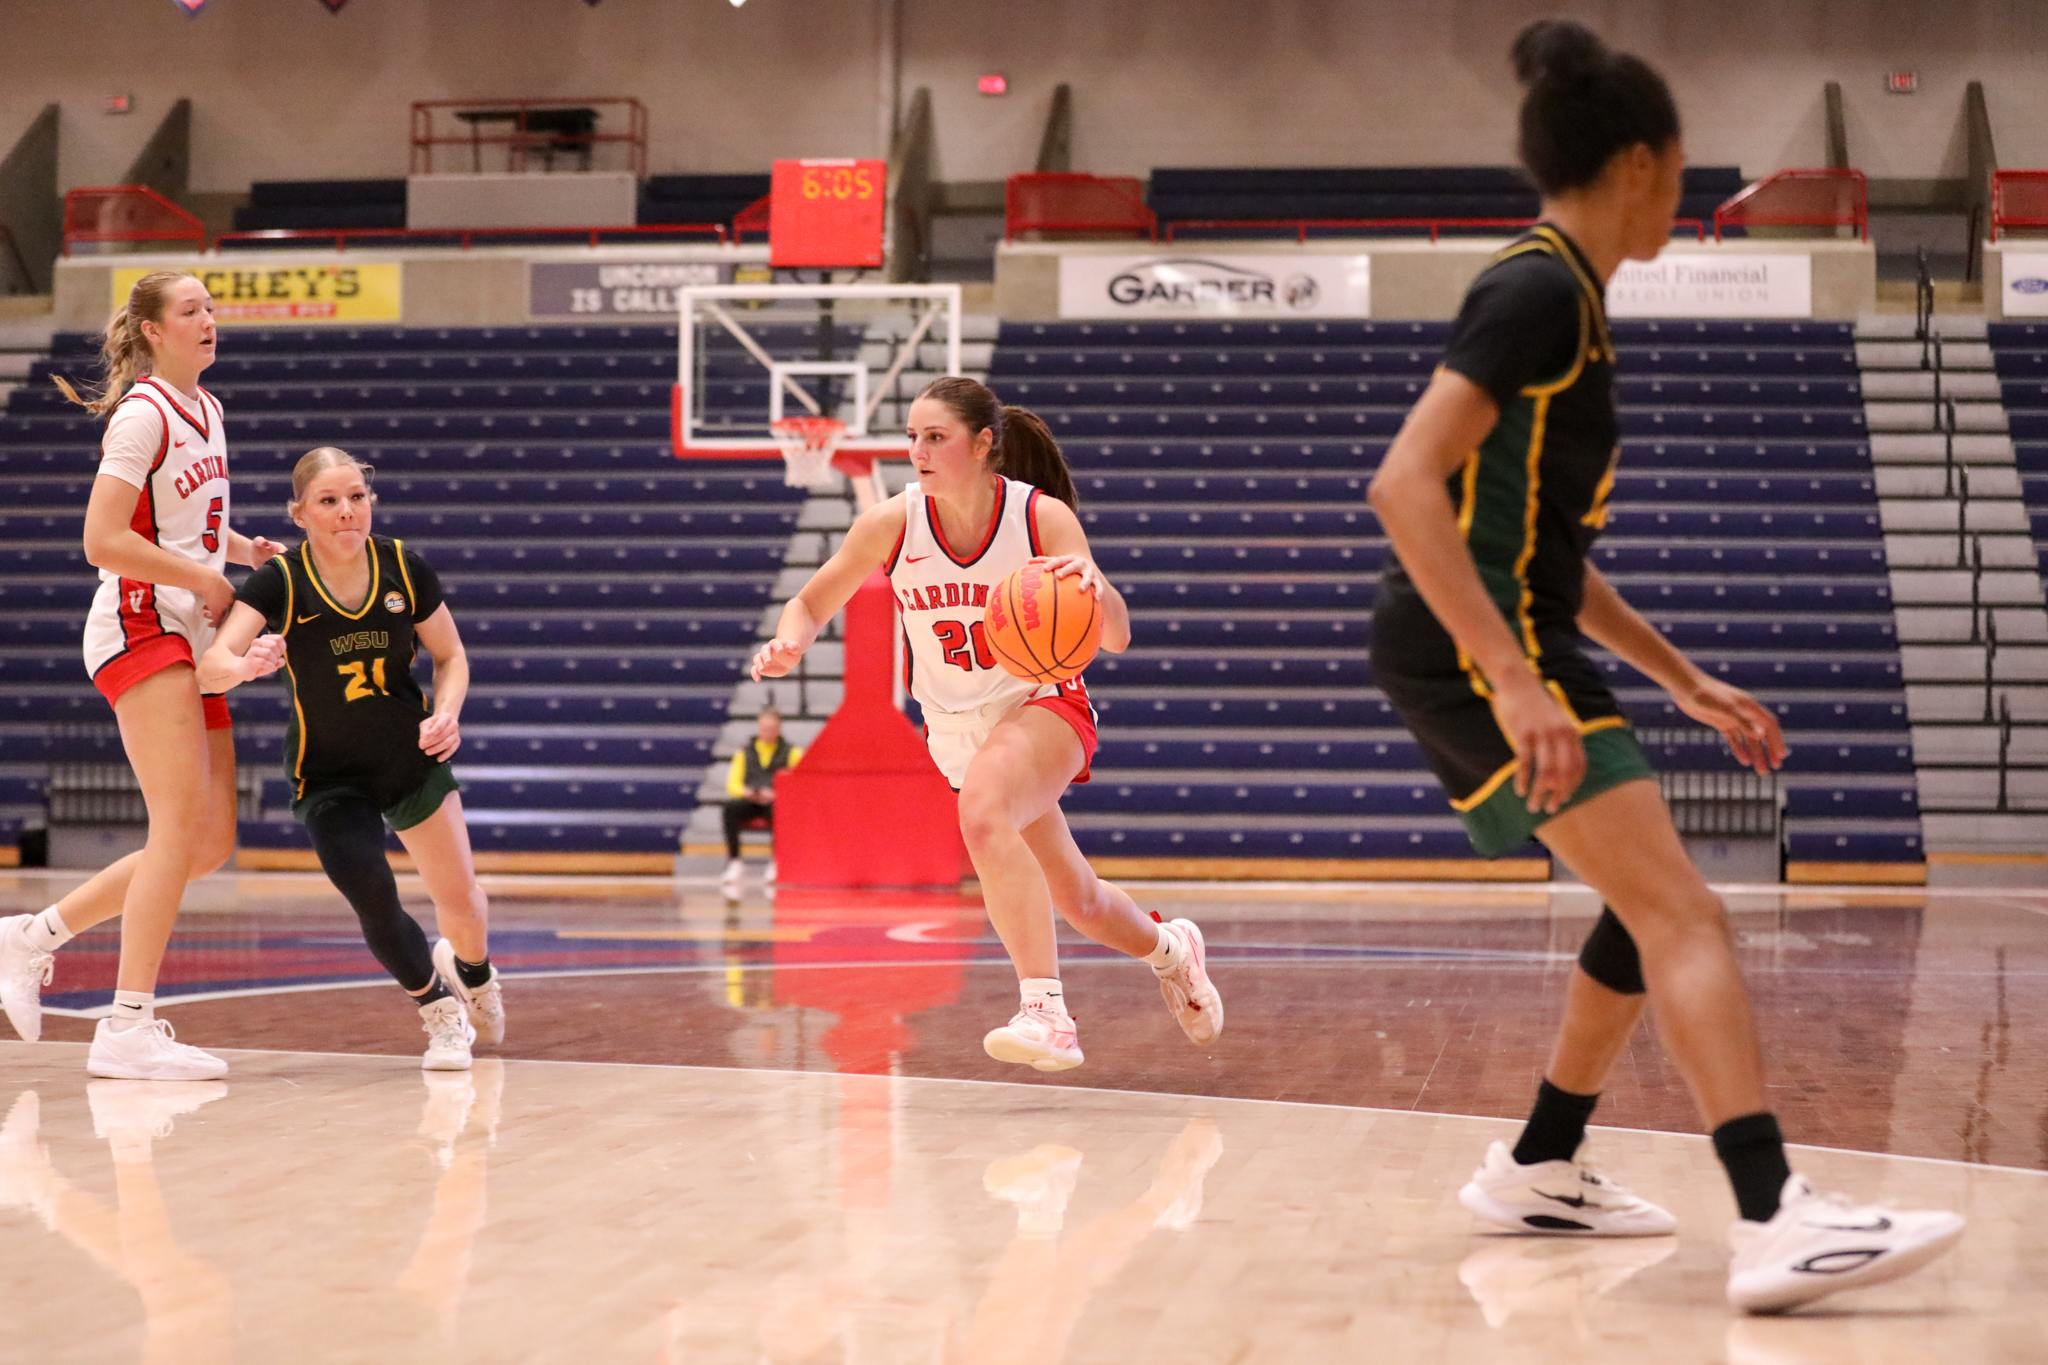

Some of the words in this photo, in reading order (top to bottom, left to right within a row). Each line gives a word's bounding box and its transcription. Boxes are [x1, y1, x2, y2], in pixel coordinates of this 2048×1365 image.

[802, 168, 873, 199] 6:05
[1675, 263, 1769, 284] Financial
[202, 496, 223, 553] 5
[902, 582, 989, 611] CARDIN
[330, 631, 389, 655] WSU
[931, 620, 998, 672] 20
[337, 658, 390, 702] 21
